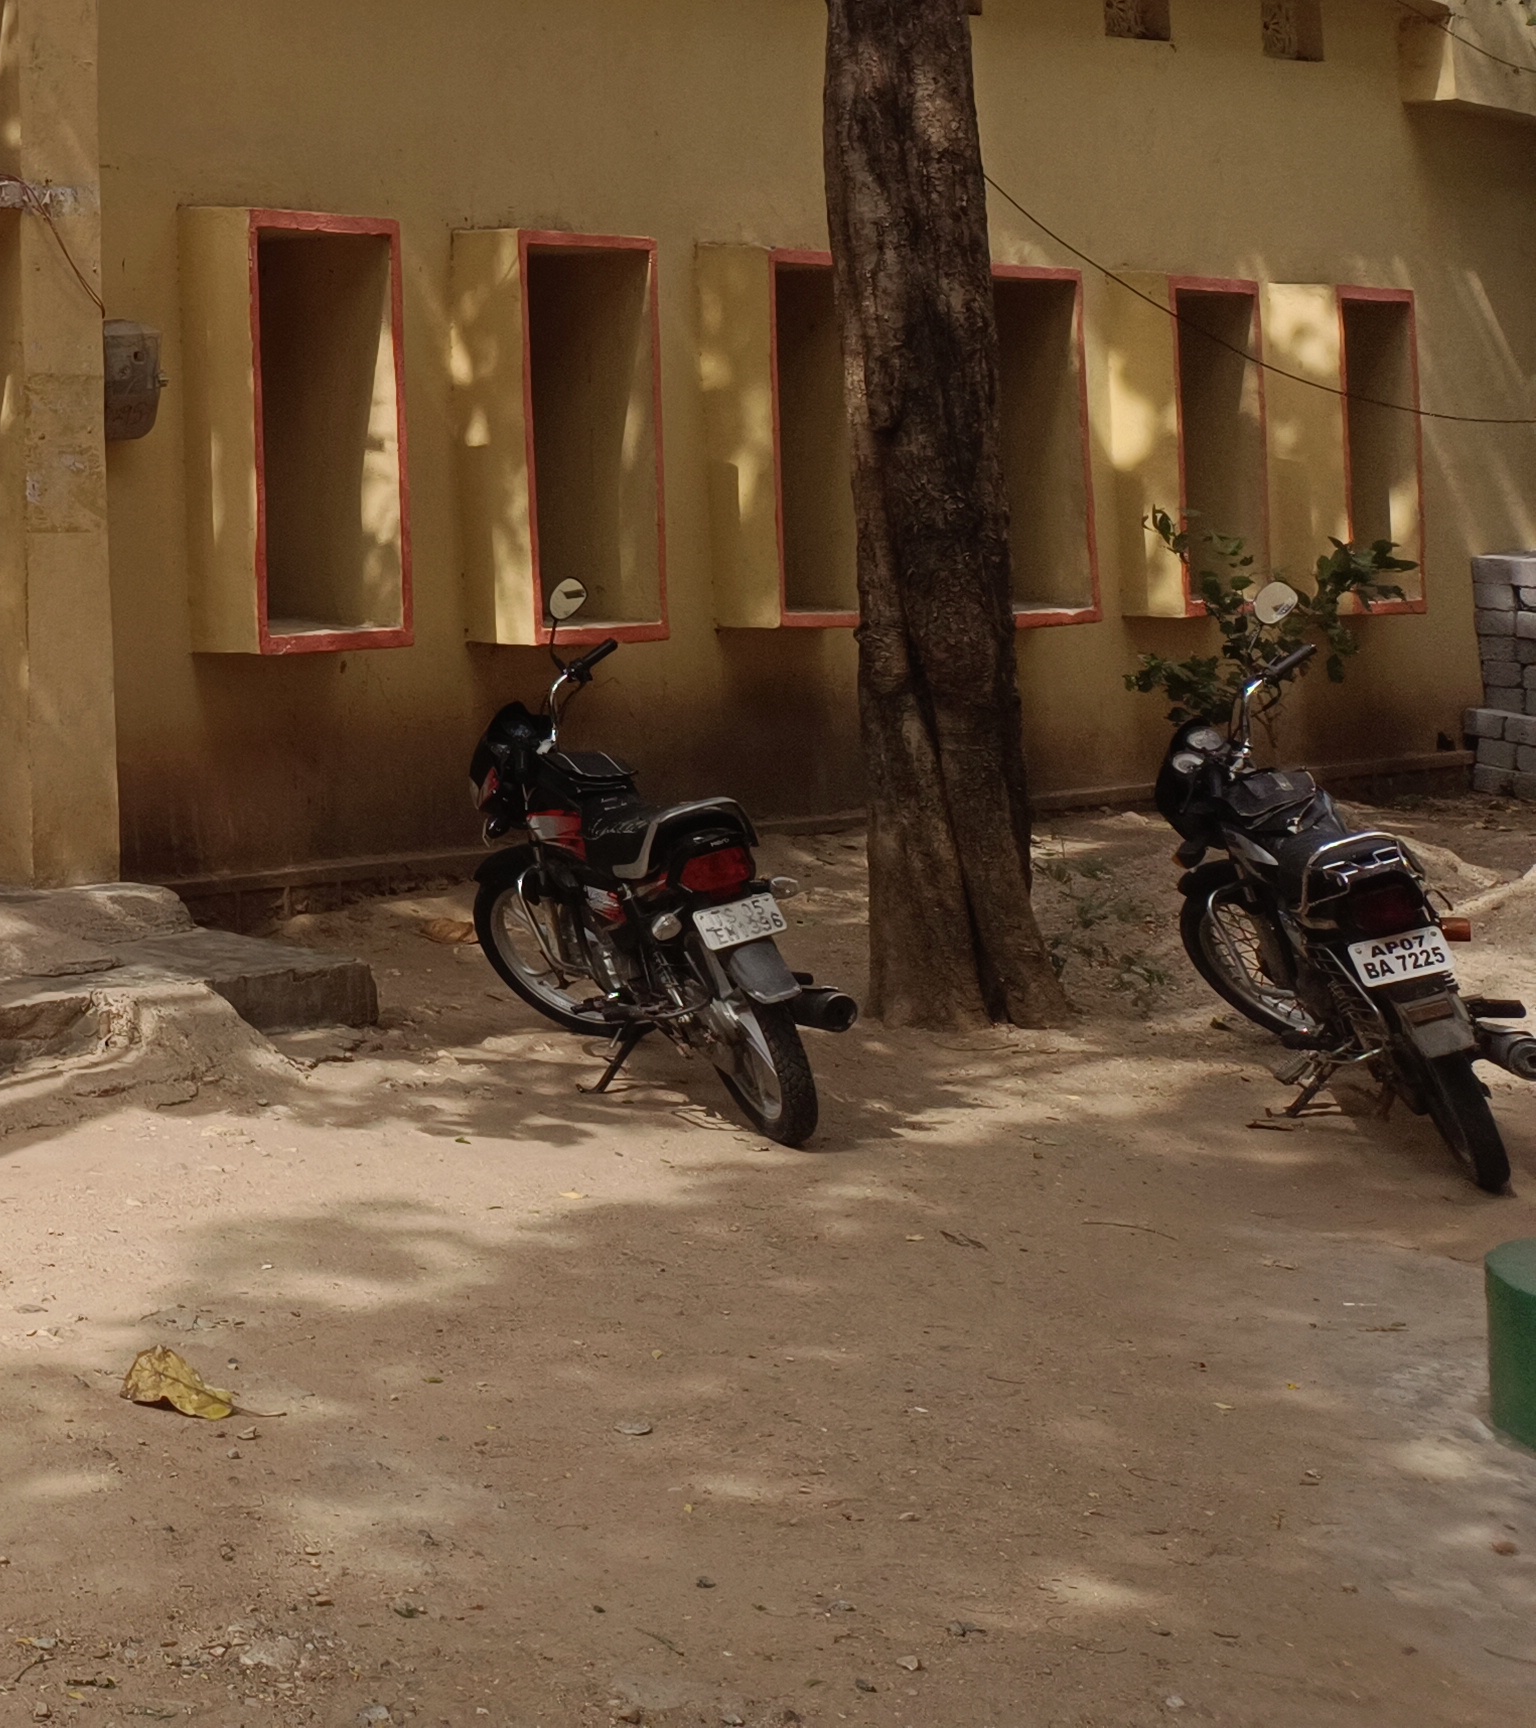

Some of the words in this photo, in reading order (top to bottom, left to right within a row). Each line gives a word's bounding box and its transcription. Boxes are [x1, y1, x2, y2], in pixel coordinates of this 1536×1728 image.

[1371, 934, 1425, 958] AP07
[1363, 959, 1395, 980] BA
[1394, 946, 1446, 972] 7225
